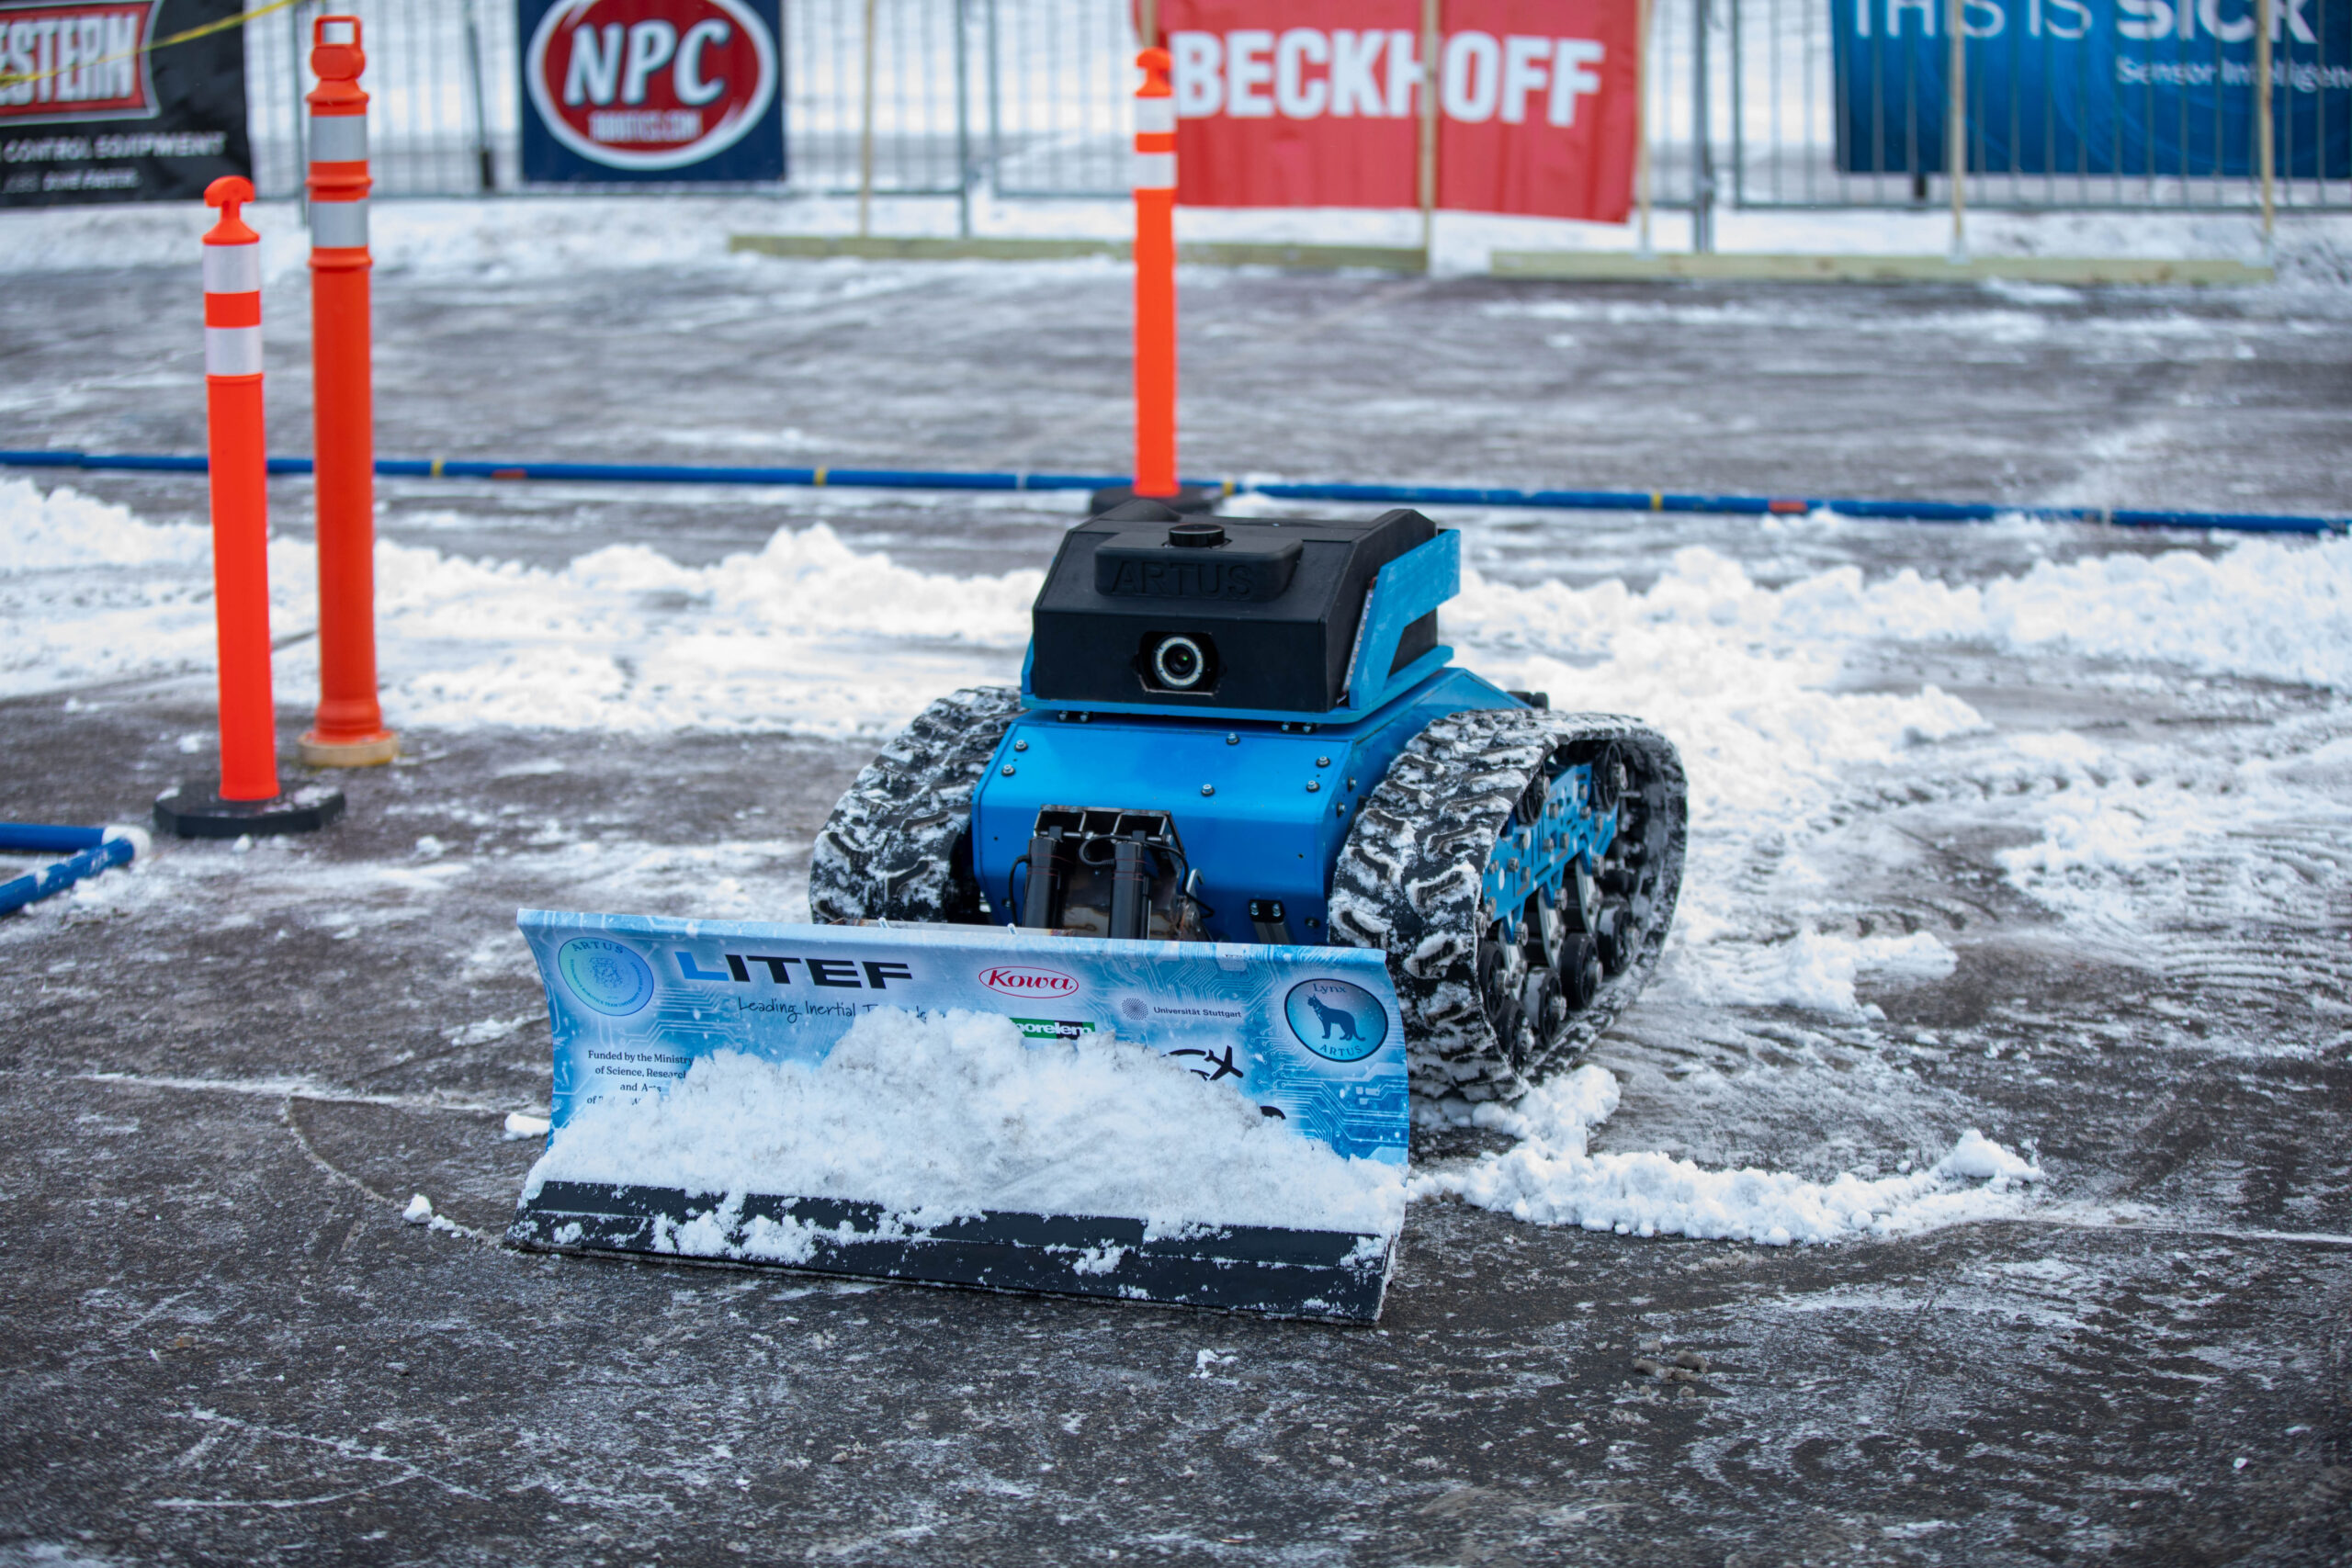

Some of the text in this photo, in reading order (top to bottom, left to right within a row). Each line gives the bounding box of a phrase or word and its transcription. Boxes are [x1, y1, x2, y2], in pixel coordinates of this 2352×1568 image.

[2116, 0, 2319, 44] SICK
[563, 18, 730, 106] NPC
[2116, 57, 2217, 85] Sensor
[1170, 28, 1605, 126] BECKHOFF
[4, 131, 226, 163] CONTROL EQUIPMENT
[1111, 559, 1253, 599] ARTUS
[571, 941, 624, 953] ARTUS
[674, 951, 913, 989] LITEF
[988, 969, 1073, 990] Kowa
[1312, 983, 1347, 994] Lynx
[738, 996, 802, 1024] Leading
[805, 999, 857, 1018] Inertial
[1153, 1006, 1242, 1018] Universität Stuttgart
[588, 1050, 694, 1066] Funded by the Ministry
[1319, 1043, 1363, 1057] ARTUS
[594, 1066, 605, 1075] of
[606, 1066, 645, 1077] Science,
[619, 1083, 638, 1091] and
[586, 1095, 598, 1105] of
